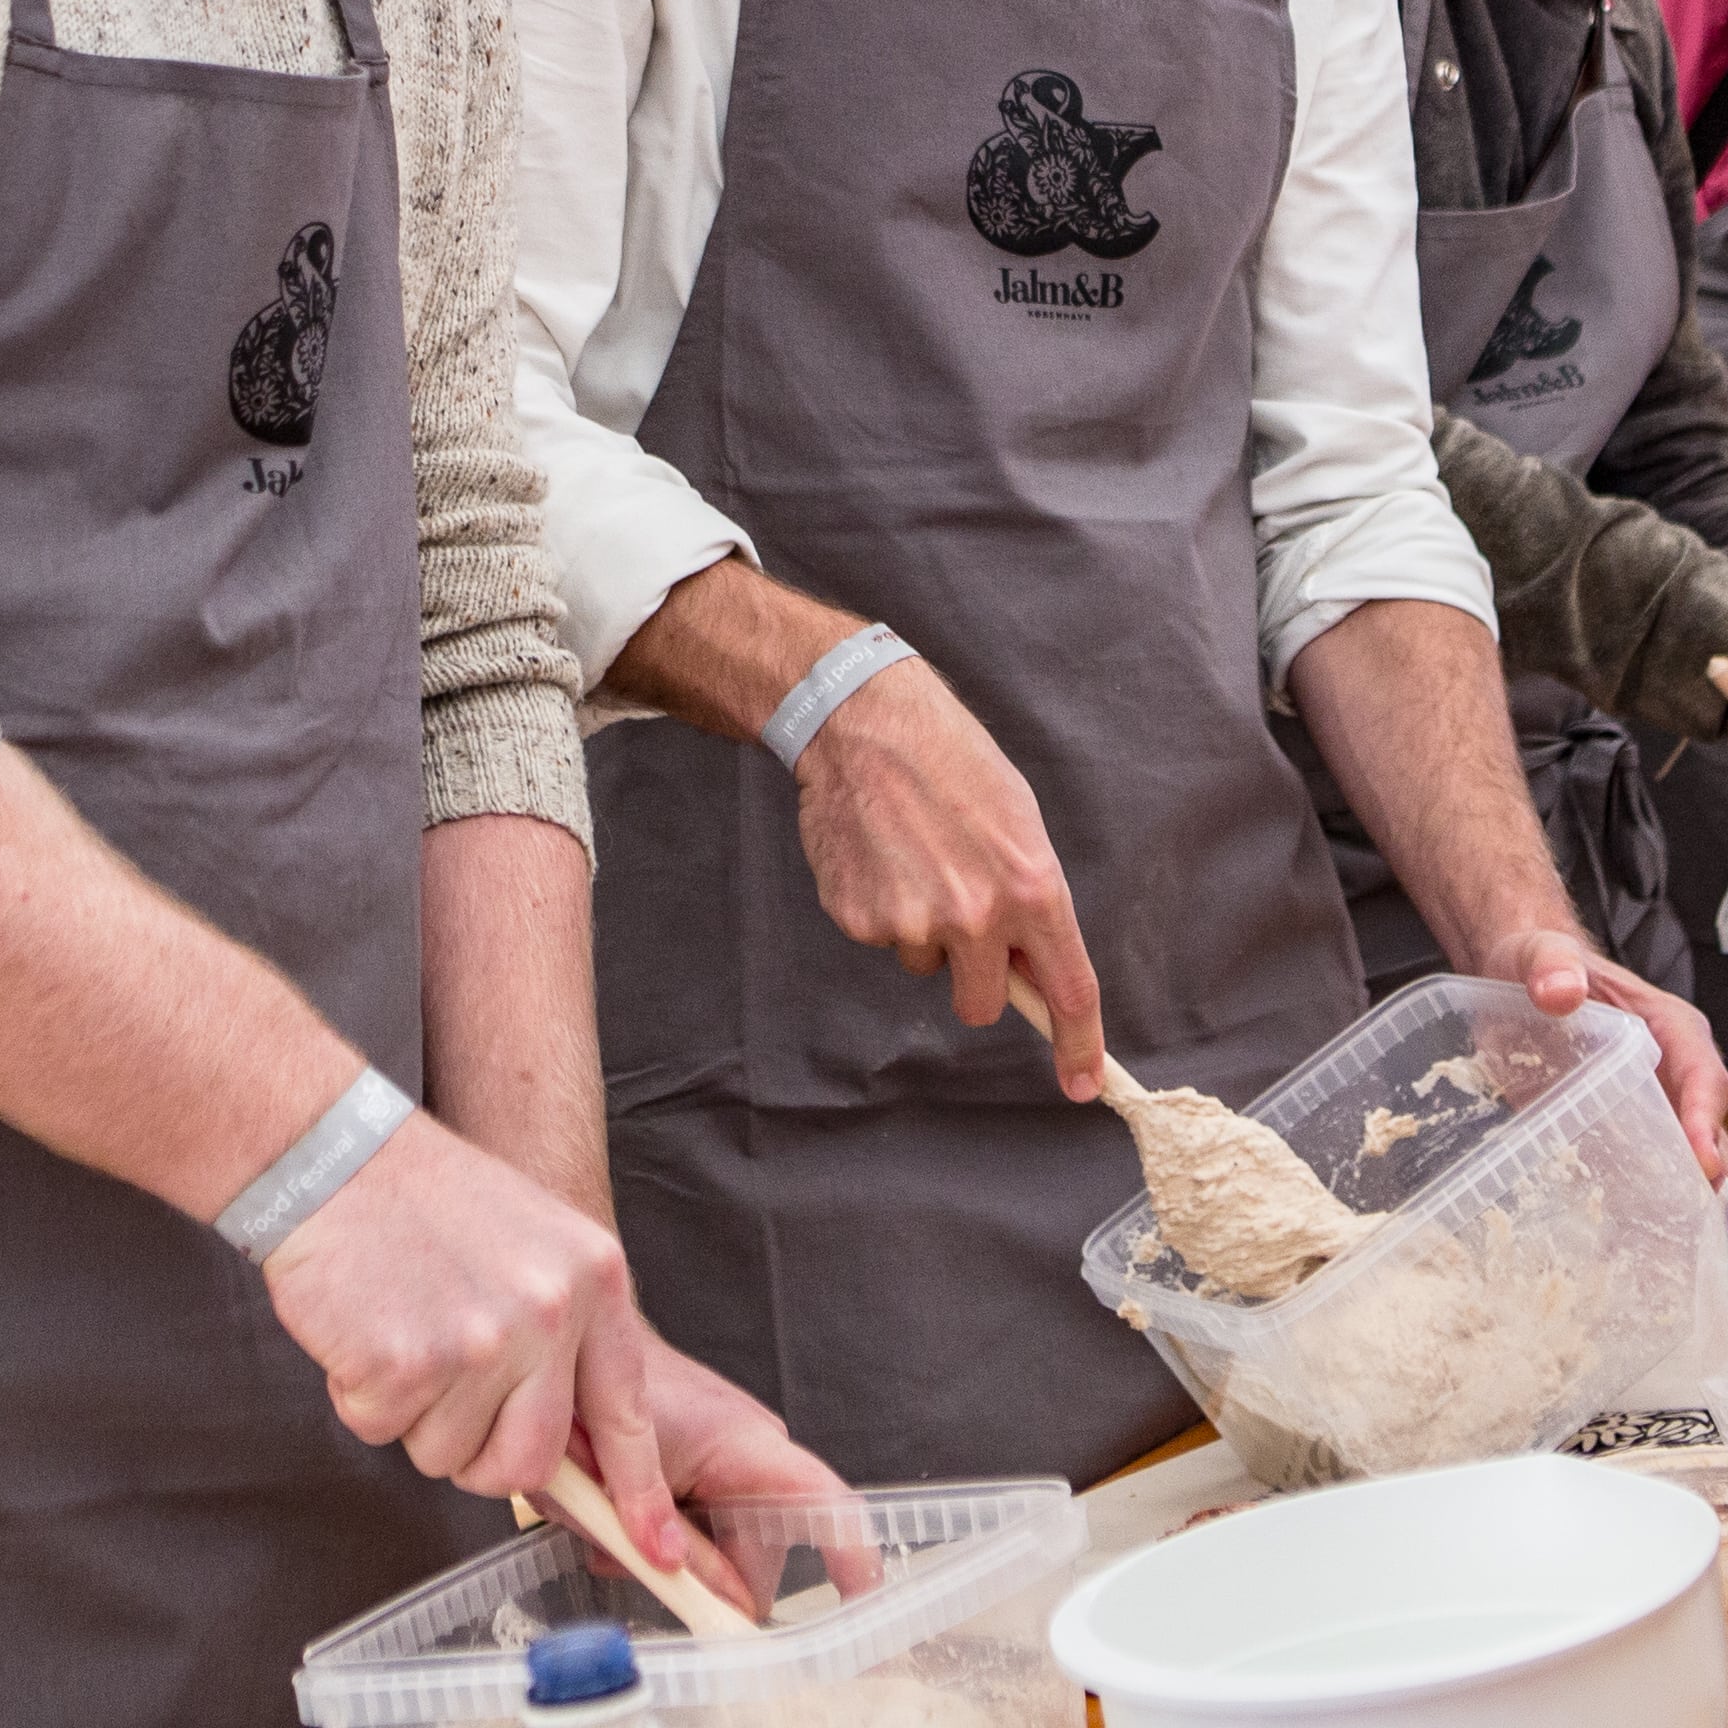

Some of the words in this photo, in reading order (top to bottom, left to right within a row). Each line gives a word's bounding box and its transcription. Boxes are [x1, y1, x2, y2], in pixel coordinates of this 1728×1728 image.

[994, 267, 1124, 308] Jalm&B
[243, 458, 304, 498] Jal
[832, 645, 876, 682] Food
[782, 677, 835, 739] Festival
[242, 1190, 292, 1241] Food
[286, 1129, 357, 1199] Festival
